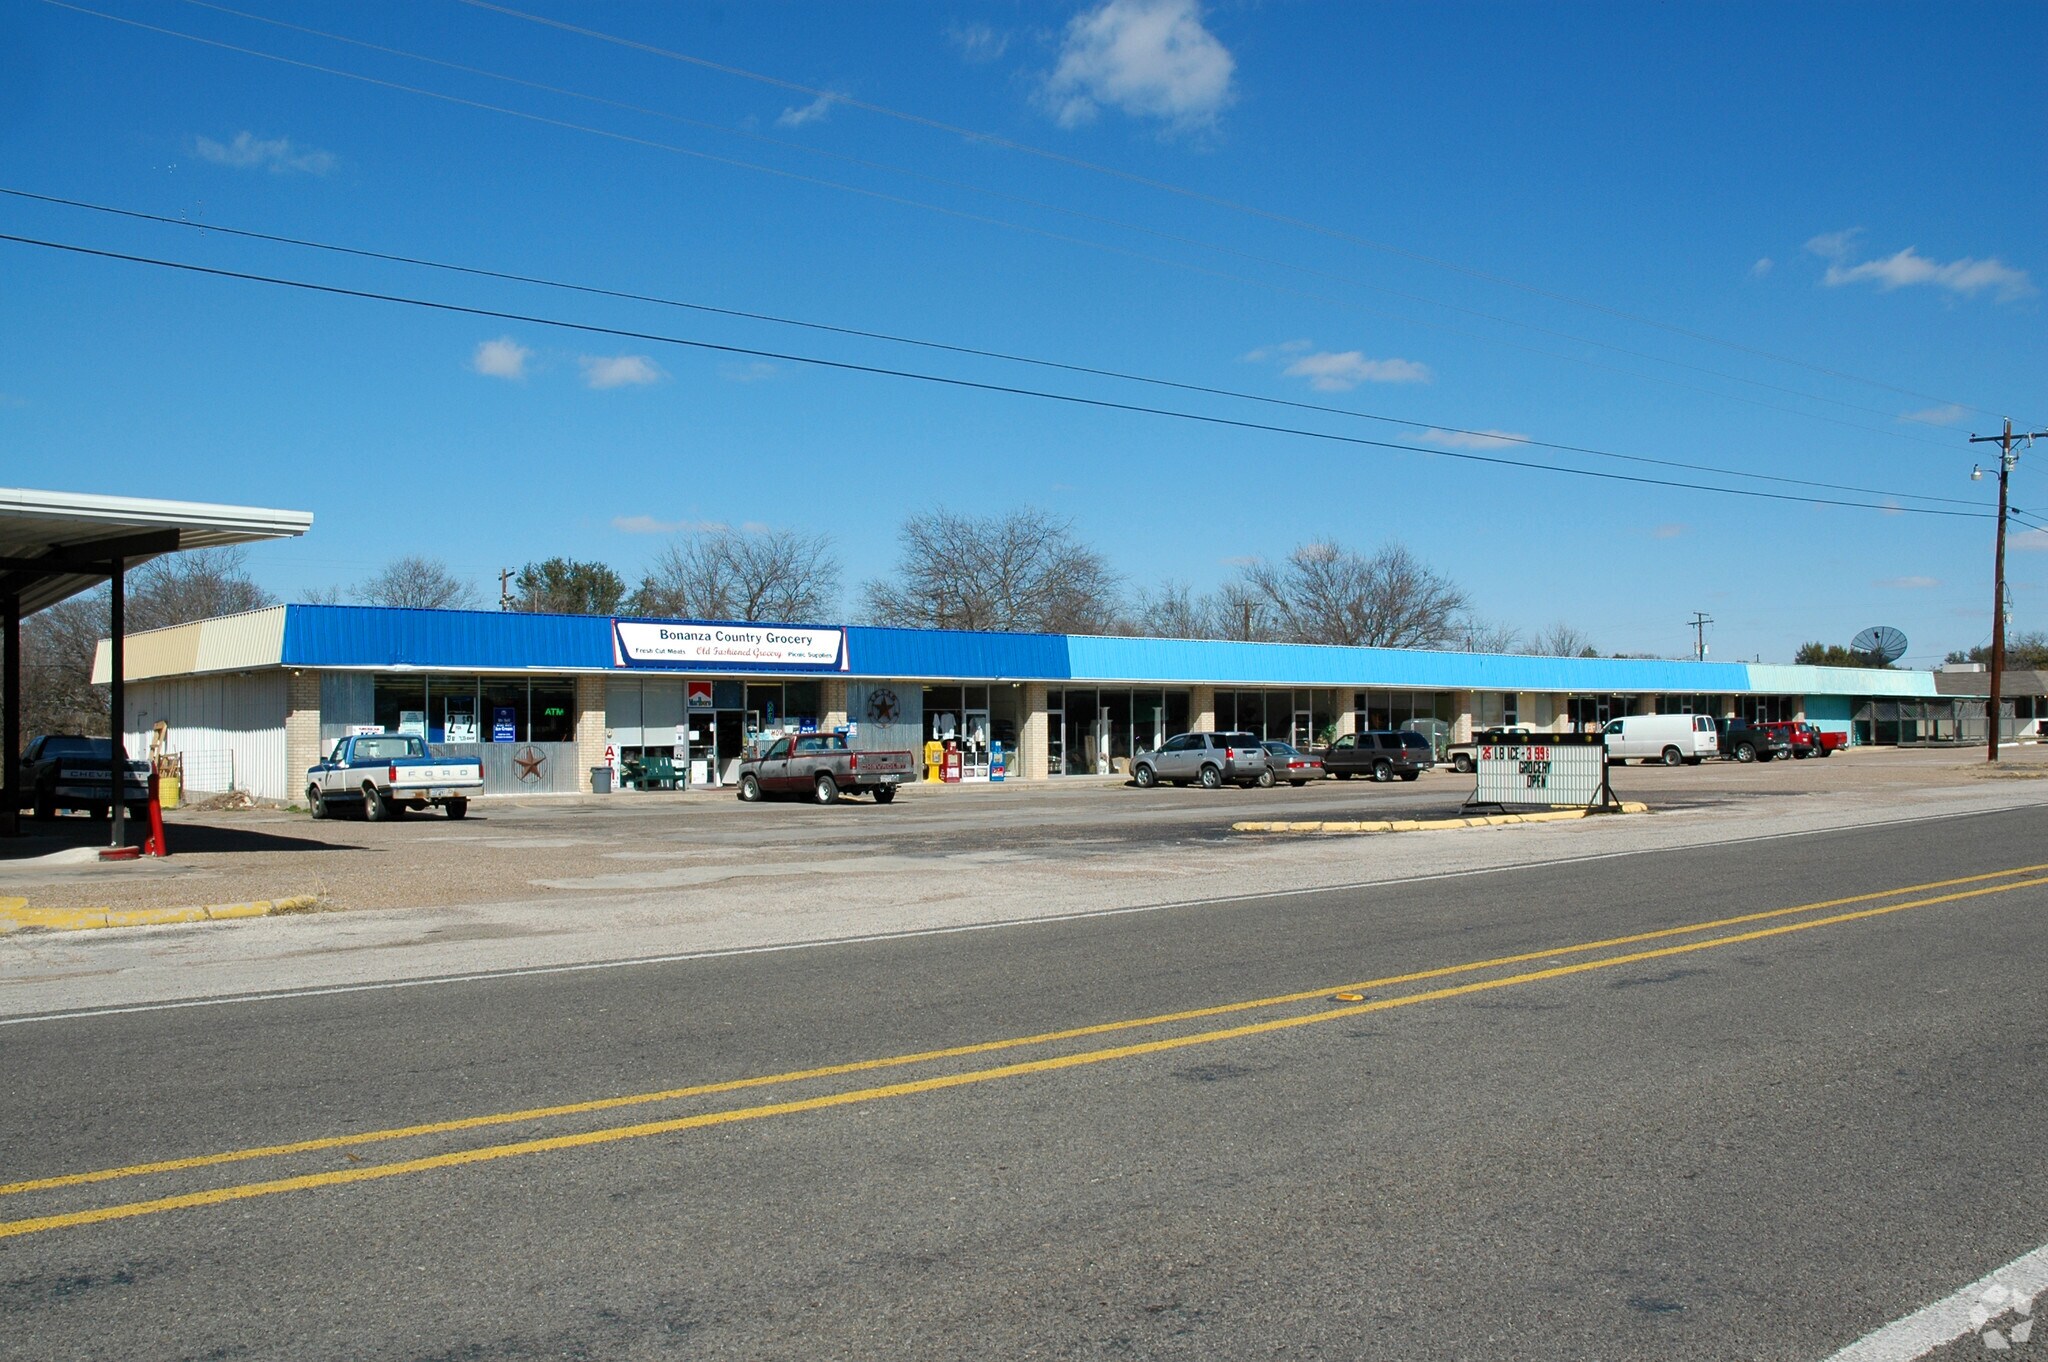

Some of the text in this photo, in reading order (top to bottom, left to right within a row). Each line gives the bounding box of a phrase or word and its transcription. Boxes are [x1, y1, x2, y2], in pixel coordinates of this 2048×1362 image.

[660, 629, 813, 647] Bonanza Country Grocery
[635, 647, 654, 655] Fresh
[667, 648, 686, 656] Meats
[696, 646, 782, 659] Old Fashioned Grocery
[787, 651, 833, 660] Picnic Supplies
[544, 708, 565, 716] ATM
[448, 715, 456, 734] 2
[1482, 747, 1492, 760] 25
[1507, 747, 1519, 760] ICE
[408, 769, 468, 777] FORD
[1519, 761, 1551, 774] GROCERY
[70, 771, 144, 779] CHEVRET
[1527, 775, 1546, 788] OPEN
